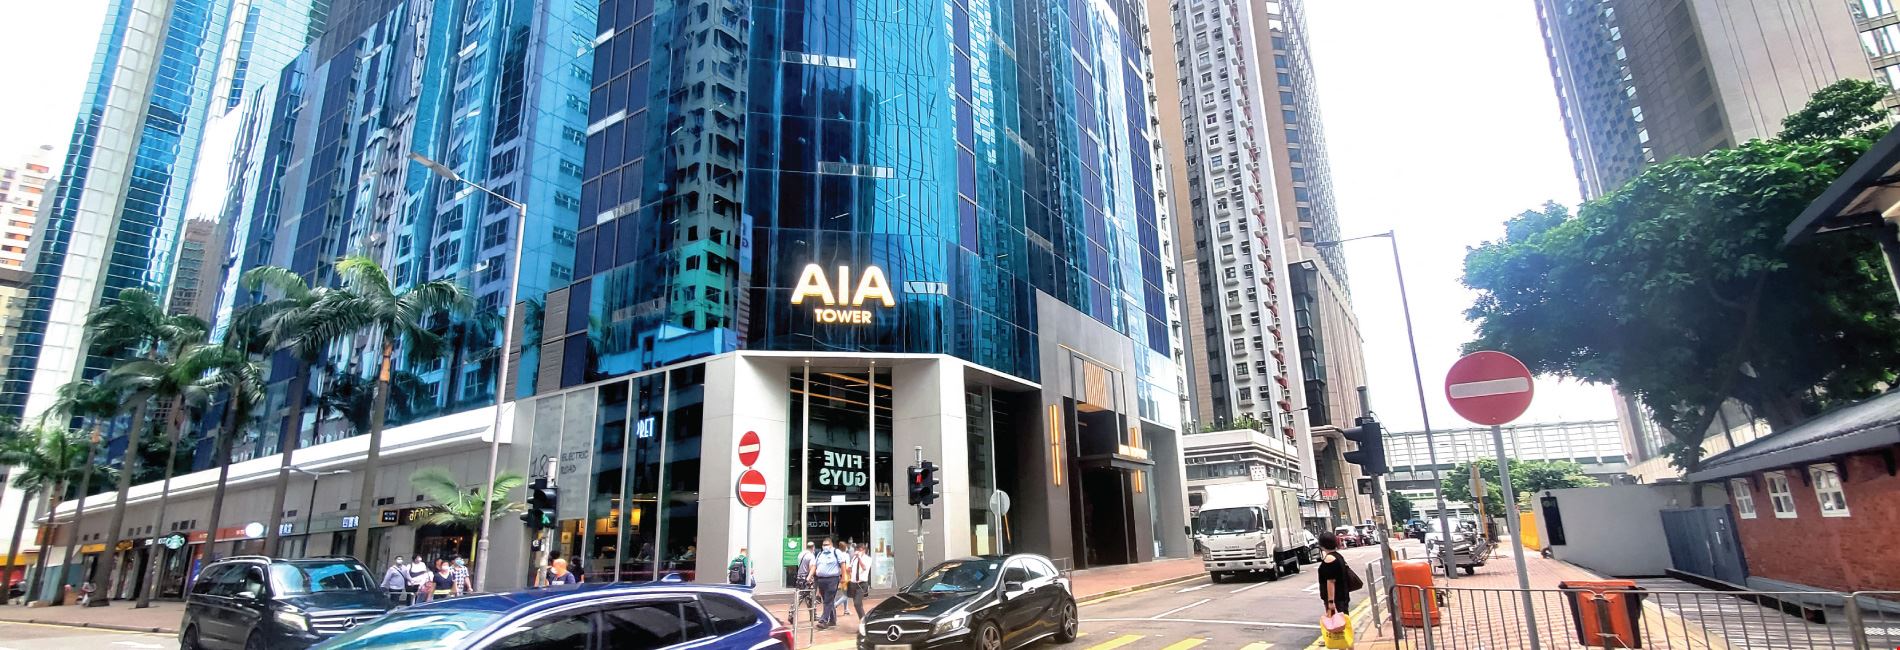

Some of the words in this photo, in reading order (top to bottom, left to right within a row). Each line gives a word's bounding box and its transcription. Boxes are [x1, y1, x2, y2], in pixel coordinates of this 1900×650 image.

[791, 263, 896, 307] AIA
[815, 308, 872, 324] TOWER
[531, 454, 549, 477] 18
